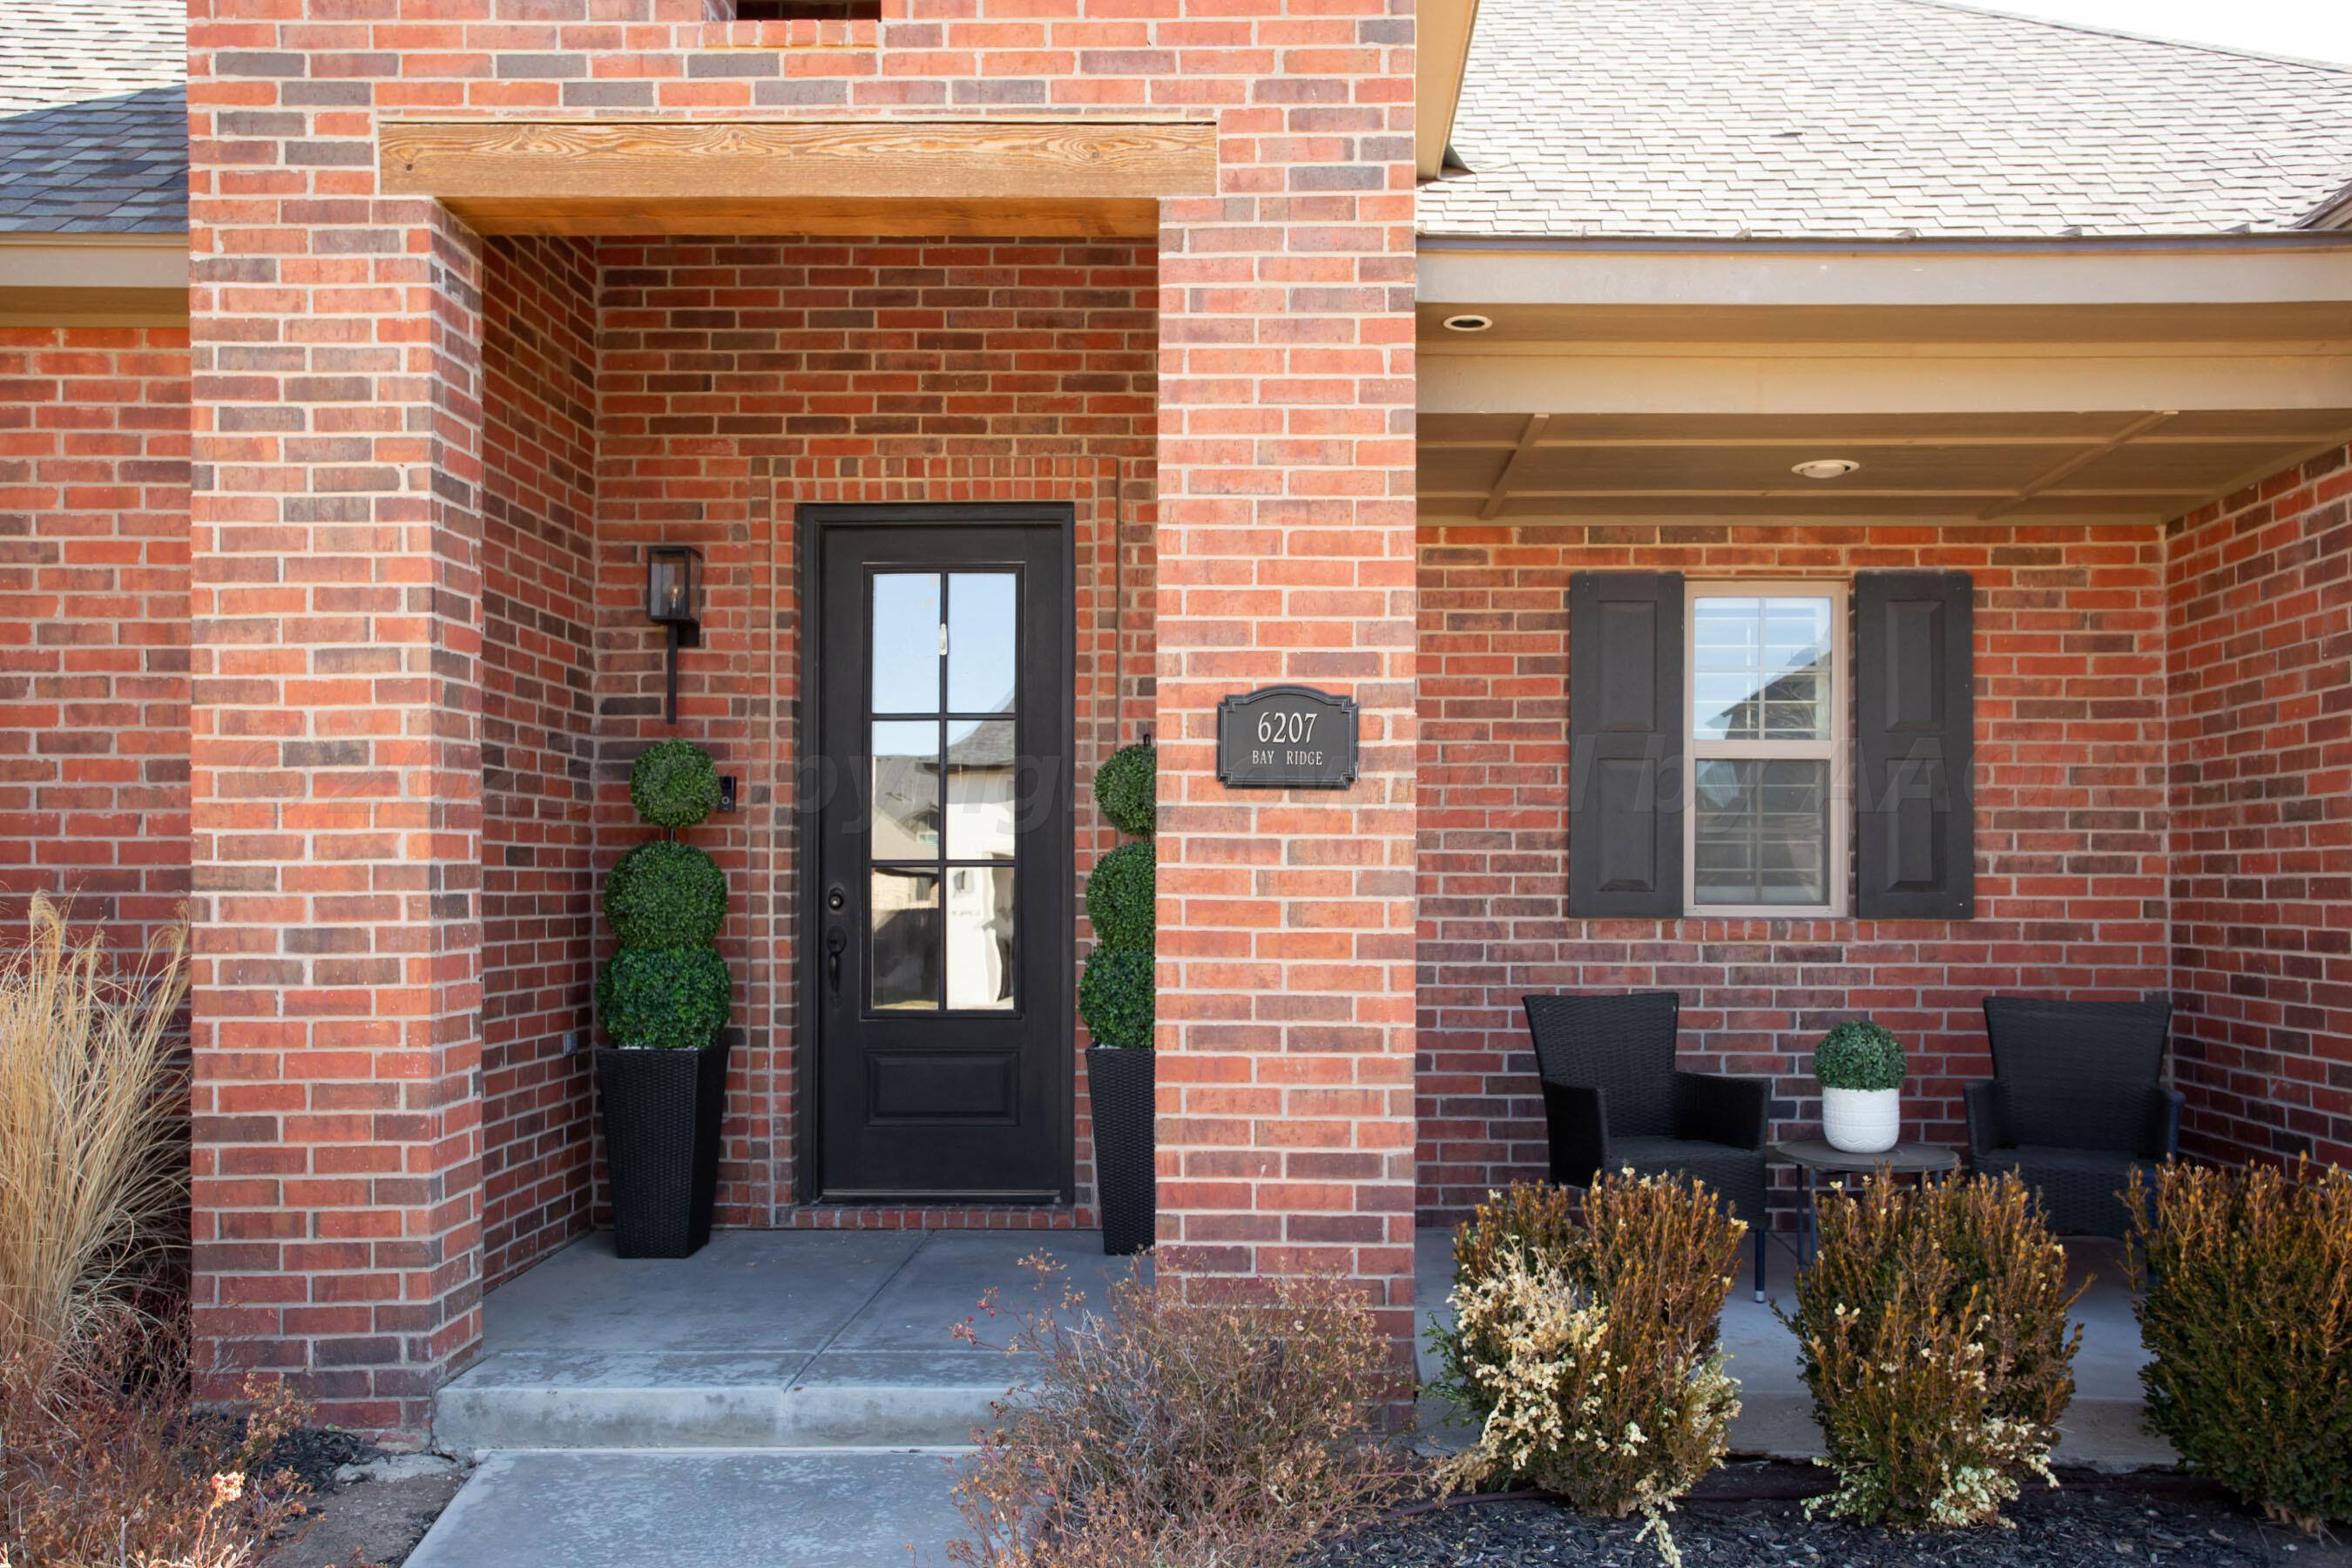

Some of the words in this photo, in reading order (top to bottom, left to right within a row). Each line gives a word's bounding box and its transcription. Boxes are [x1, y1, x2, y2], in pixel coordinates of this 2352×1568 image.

[1257, 712, 1318, 743] 6207
[1252, 750, 1274, 765] BAY
[1287, 751, 1323, 765] RIDGE
